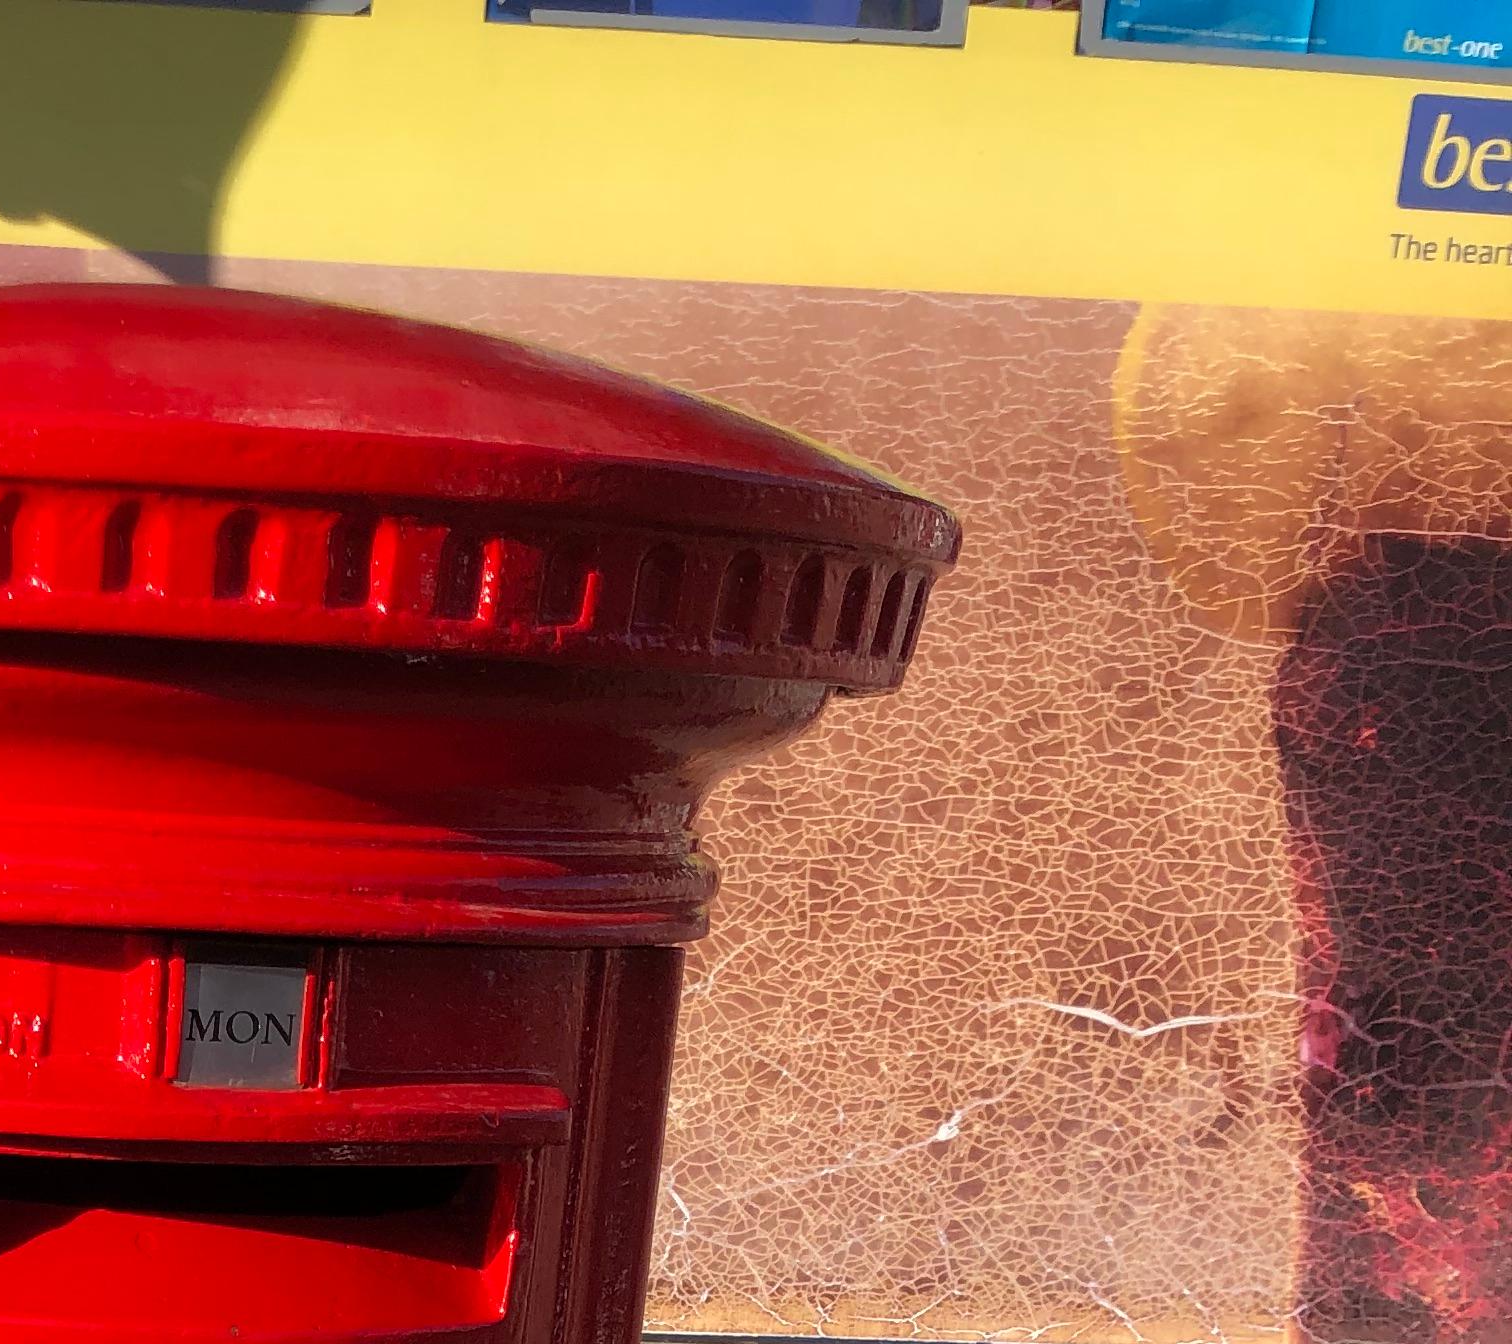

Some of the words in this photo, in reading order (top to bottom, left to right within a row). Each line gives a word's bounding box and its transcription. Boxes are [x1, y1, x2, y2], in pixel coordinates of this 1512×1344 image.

[1403, 29, 1503, 59] best-one
[1422, 113, 1512, 193] be
[1390, 233, 1438, 261] The
[185, 1008, 296, 1046] MON
